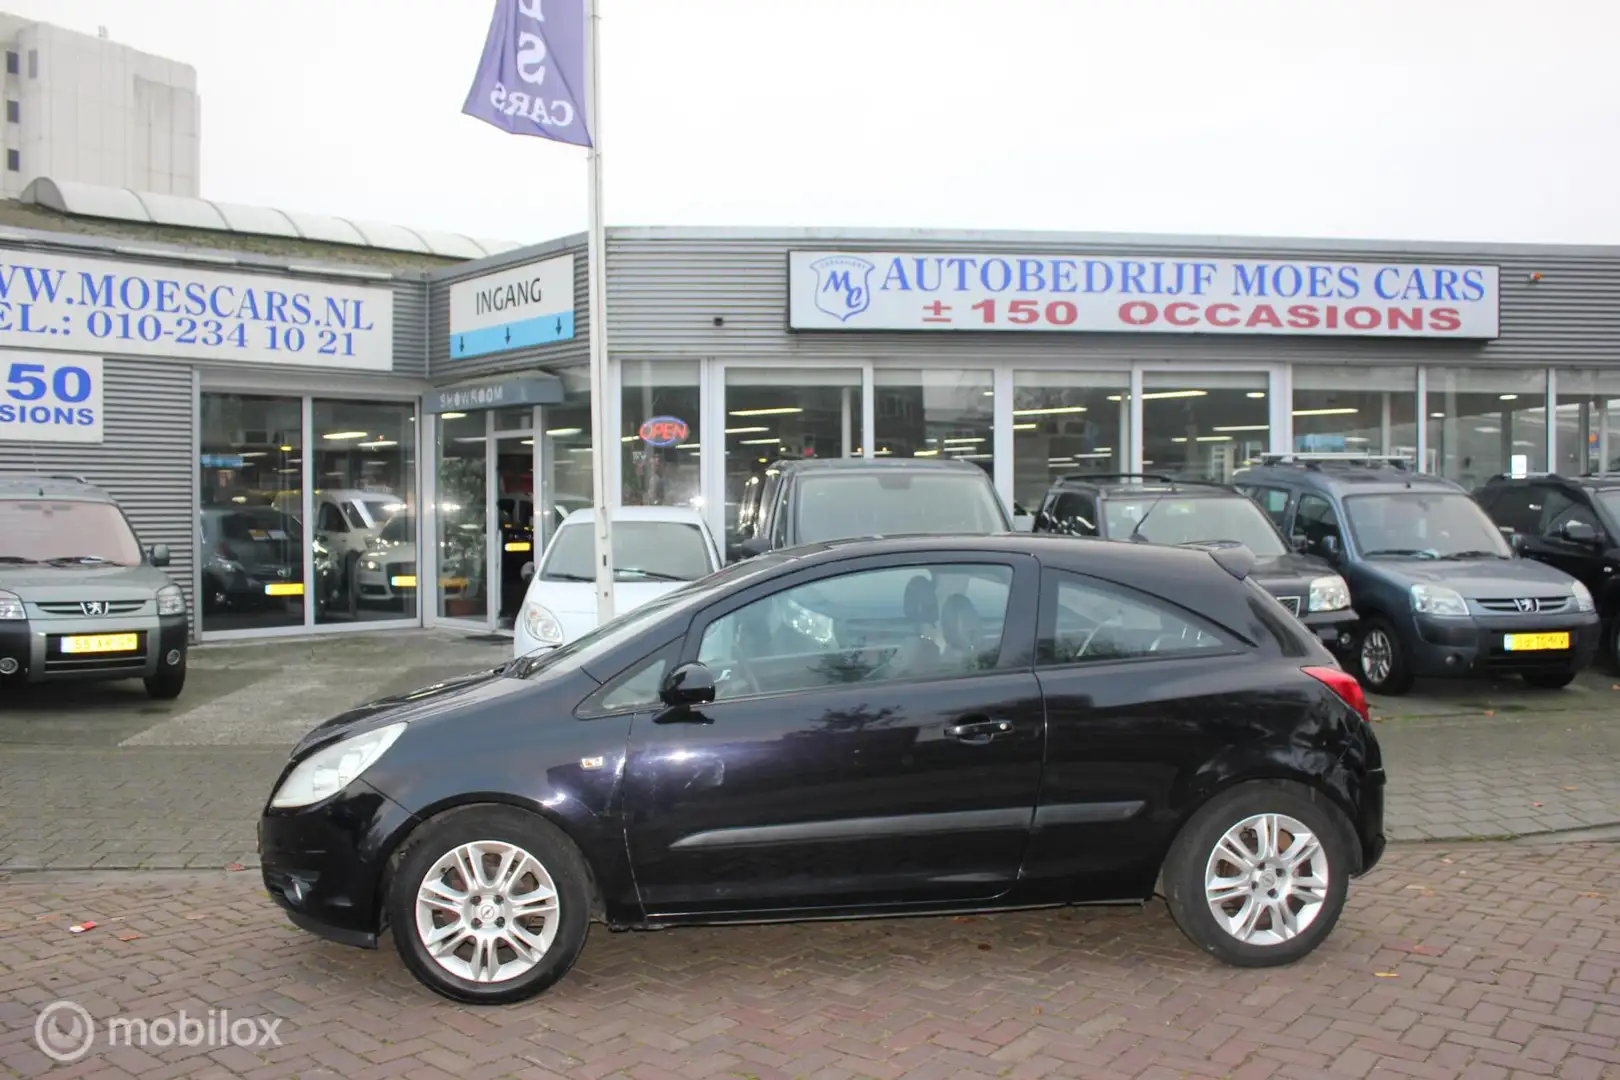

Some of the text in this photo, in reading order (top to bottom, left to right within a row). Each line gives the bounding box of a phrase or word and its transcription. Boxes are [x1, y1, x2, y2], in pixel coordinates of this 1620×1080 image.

[475, 277, 542, 315] INGANG
[880, 254, 1486, 303] AUTOBEDRIJF MOES CARS
[970, 299, 1078, 325] 150
[1117, 301, 1461, 331] OCCASIONS
[86, 310, 247, 349] 010-234
[267, 324, 306, 352] 10
[316, 330, 357, 357] 21
[5, 363, 92, 403] 50
[440, 385, 503, 409] SHOWROOM
[0, 404, 95, 426] SIONS
[639, 422, 688, 441] OPEN
